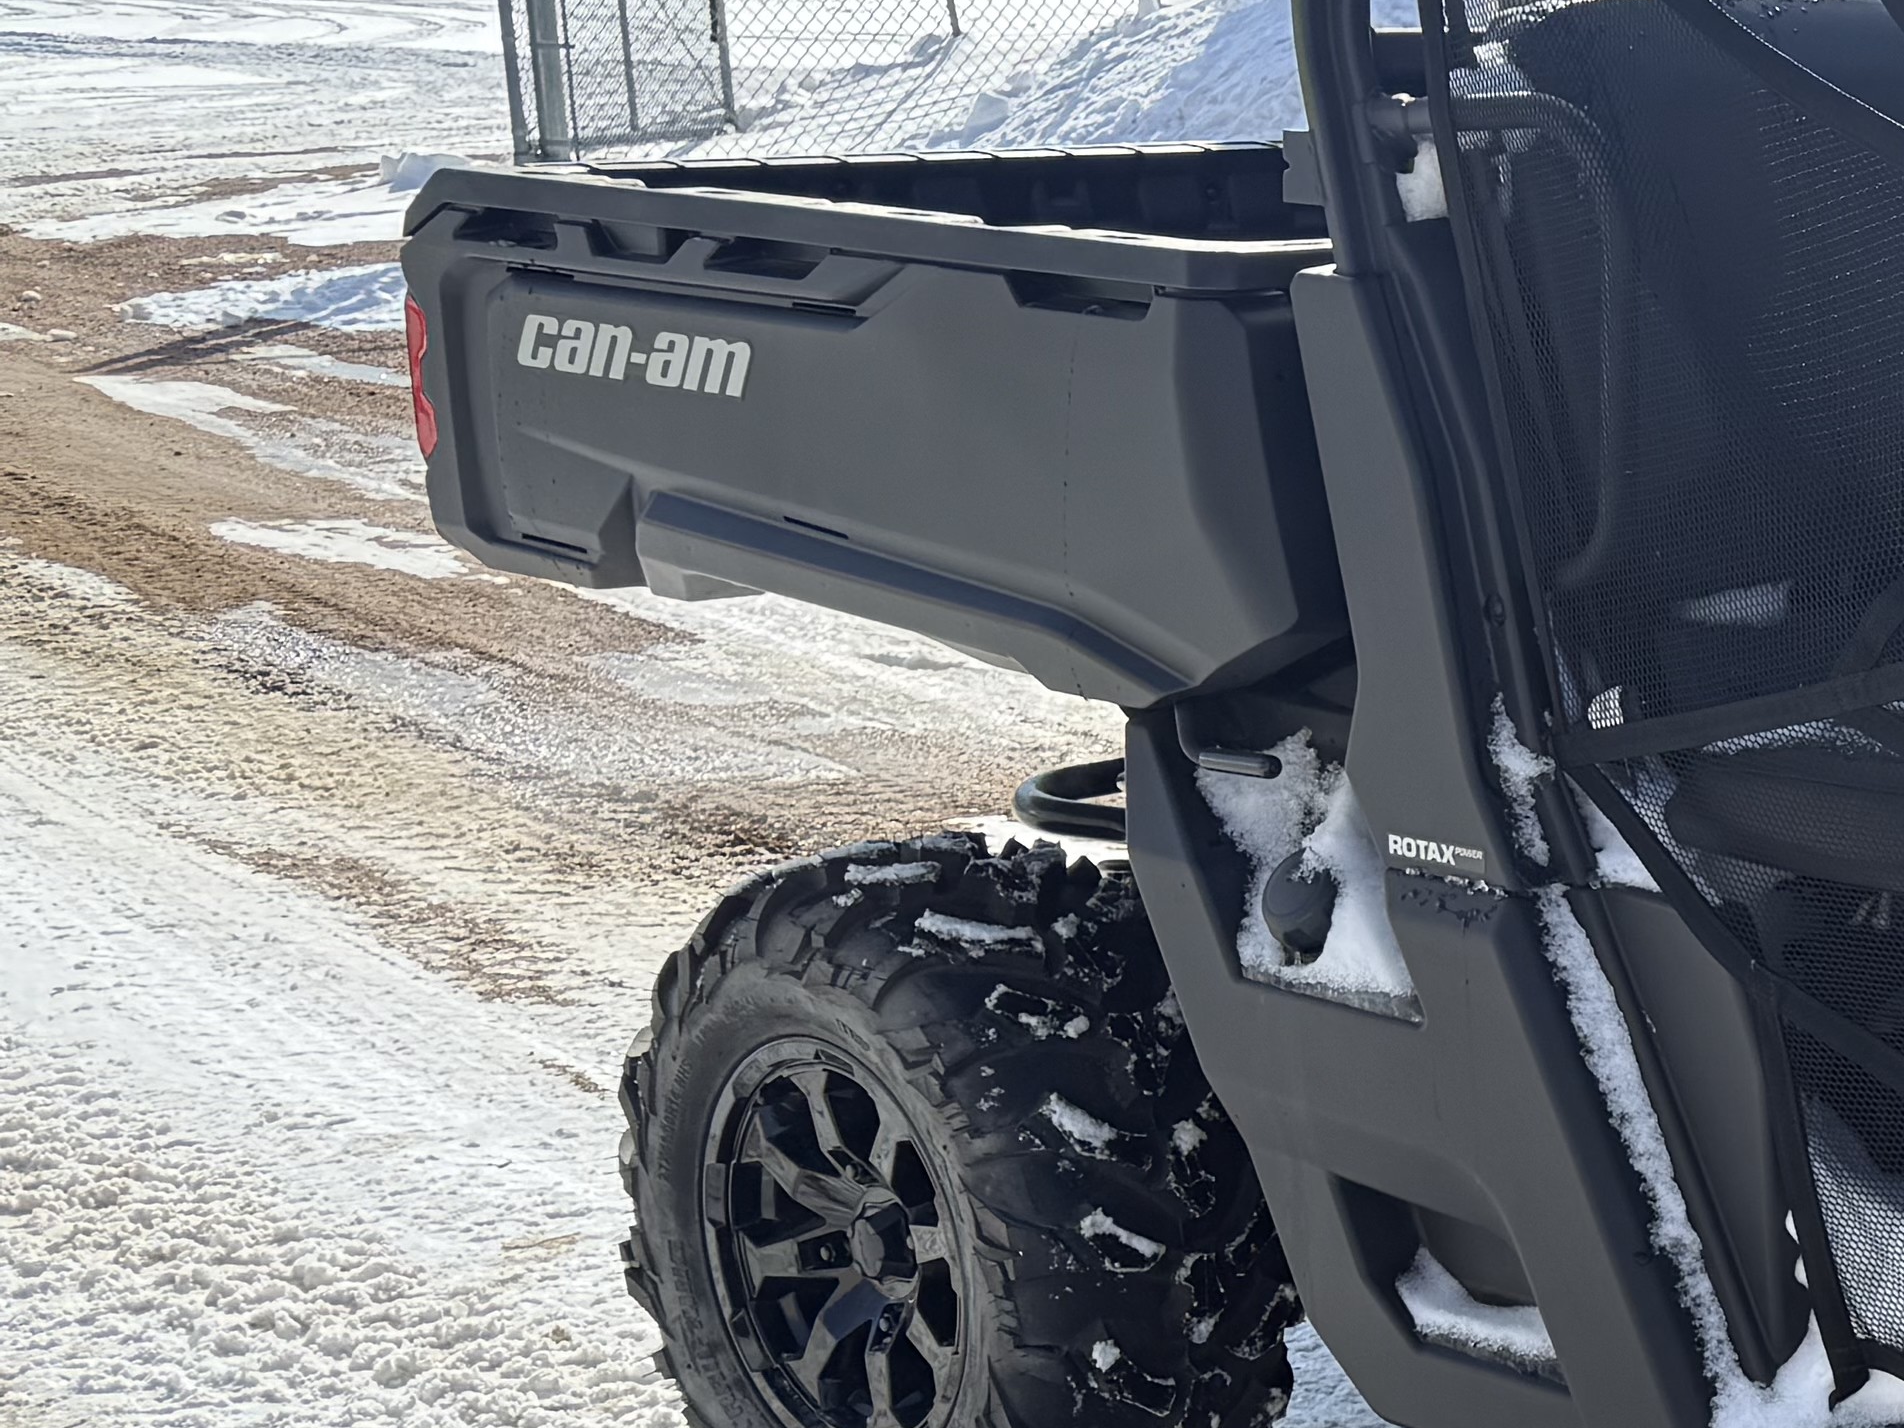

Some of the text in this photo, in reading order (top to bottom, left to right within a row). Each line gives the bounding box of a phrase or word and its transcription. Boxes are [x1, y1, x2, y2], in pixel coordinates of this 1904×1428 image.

[517, 313, 751, 398] can-am
[1388, 833, 1484, 866] ROTAX POWER
